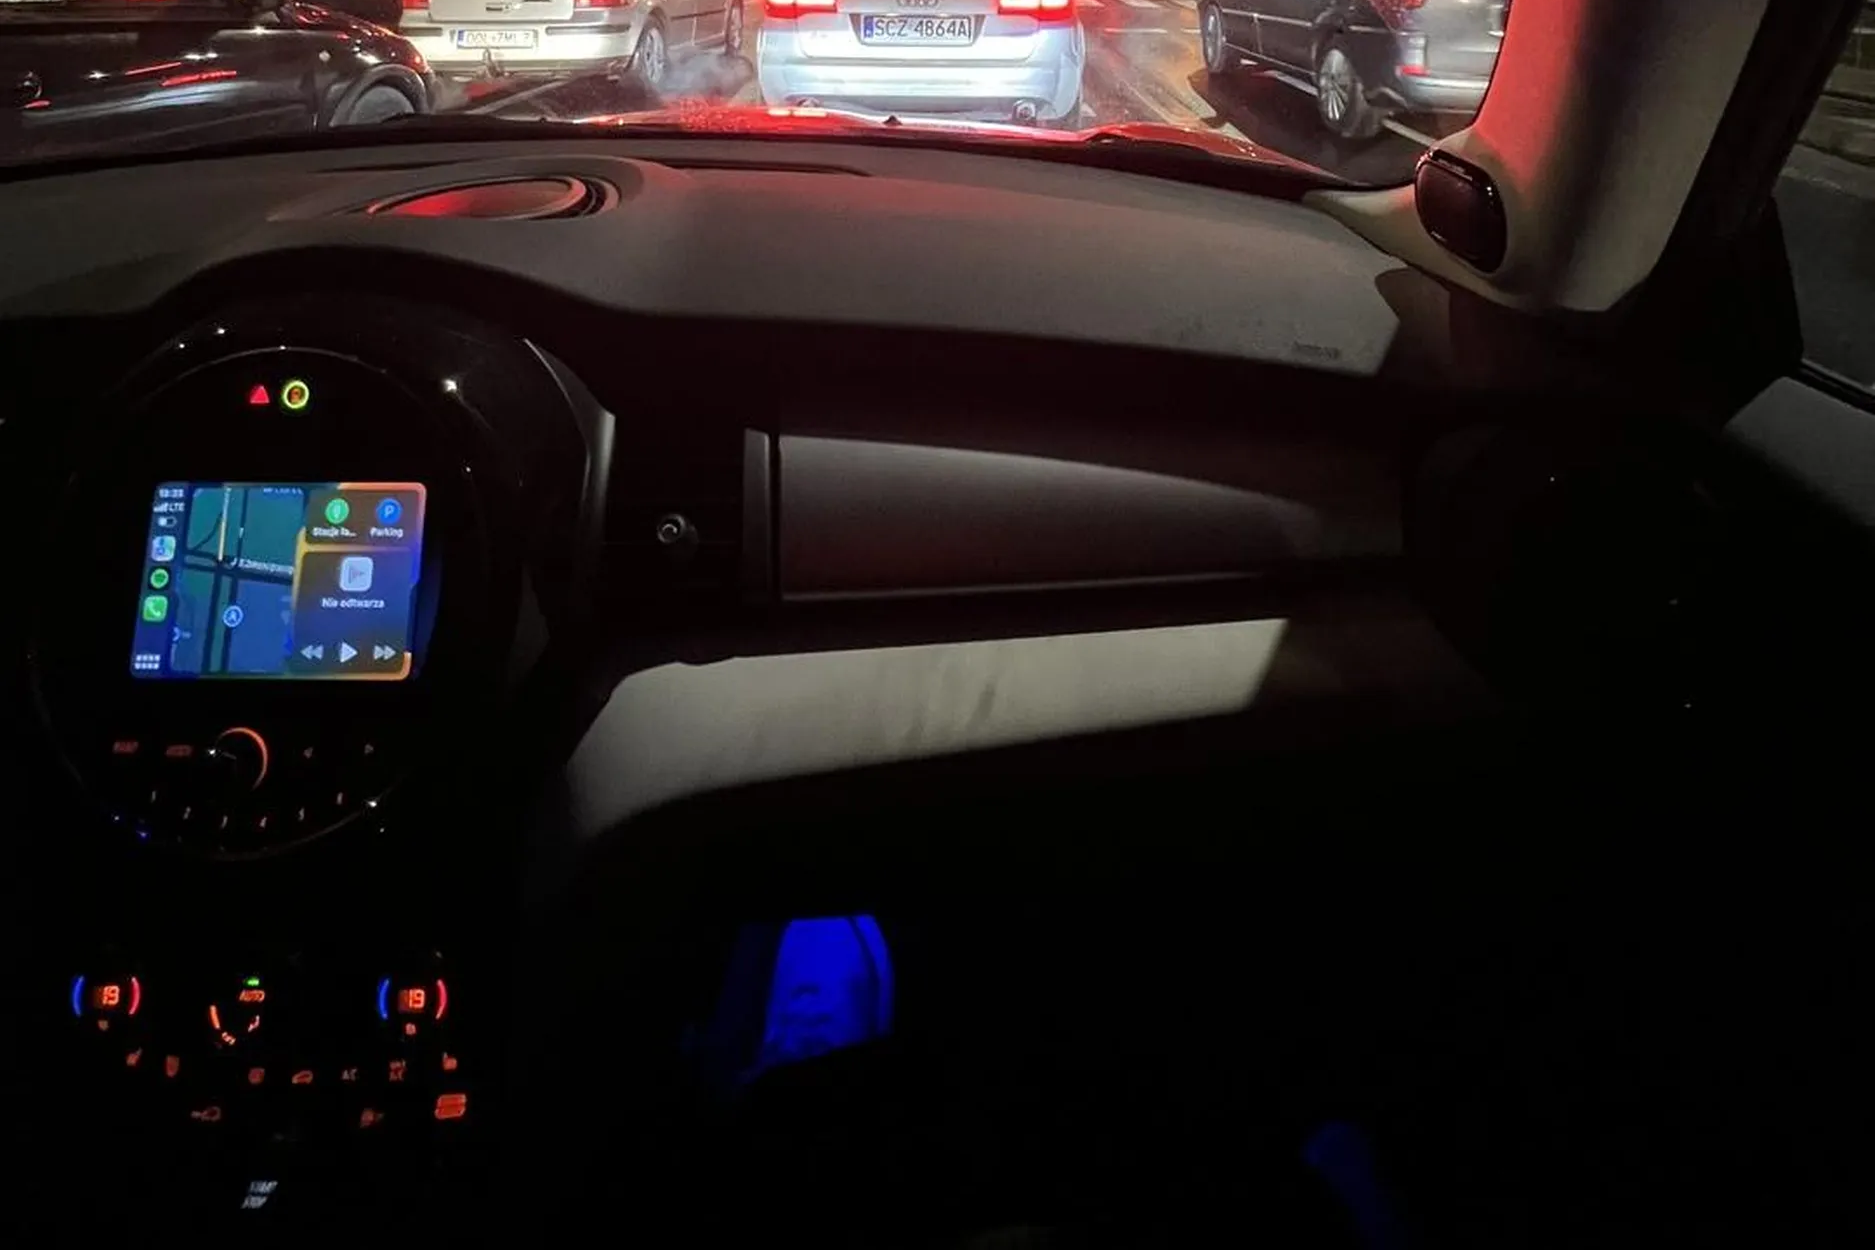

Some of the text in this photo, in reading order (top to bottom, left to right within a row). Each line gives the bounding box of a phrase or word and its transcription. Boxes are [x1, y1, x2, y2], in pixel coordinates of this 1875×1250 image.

[874, 19, 967, 37] SCZ 4864A
[370, 527, 403, 538] Parking
[321, 597, 385, 609] Nie odtwarza
[102, 985, 120, 1006] 19
[239, 989, 265, 1002] AUTO
[409, 989, 425, 1009] 19
